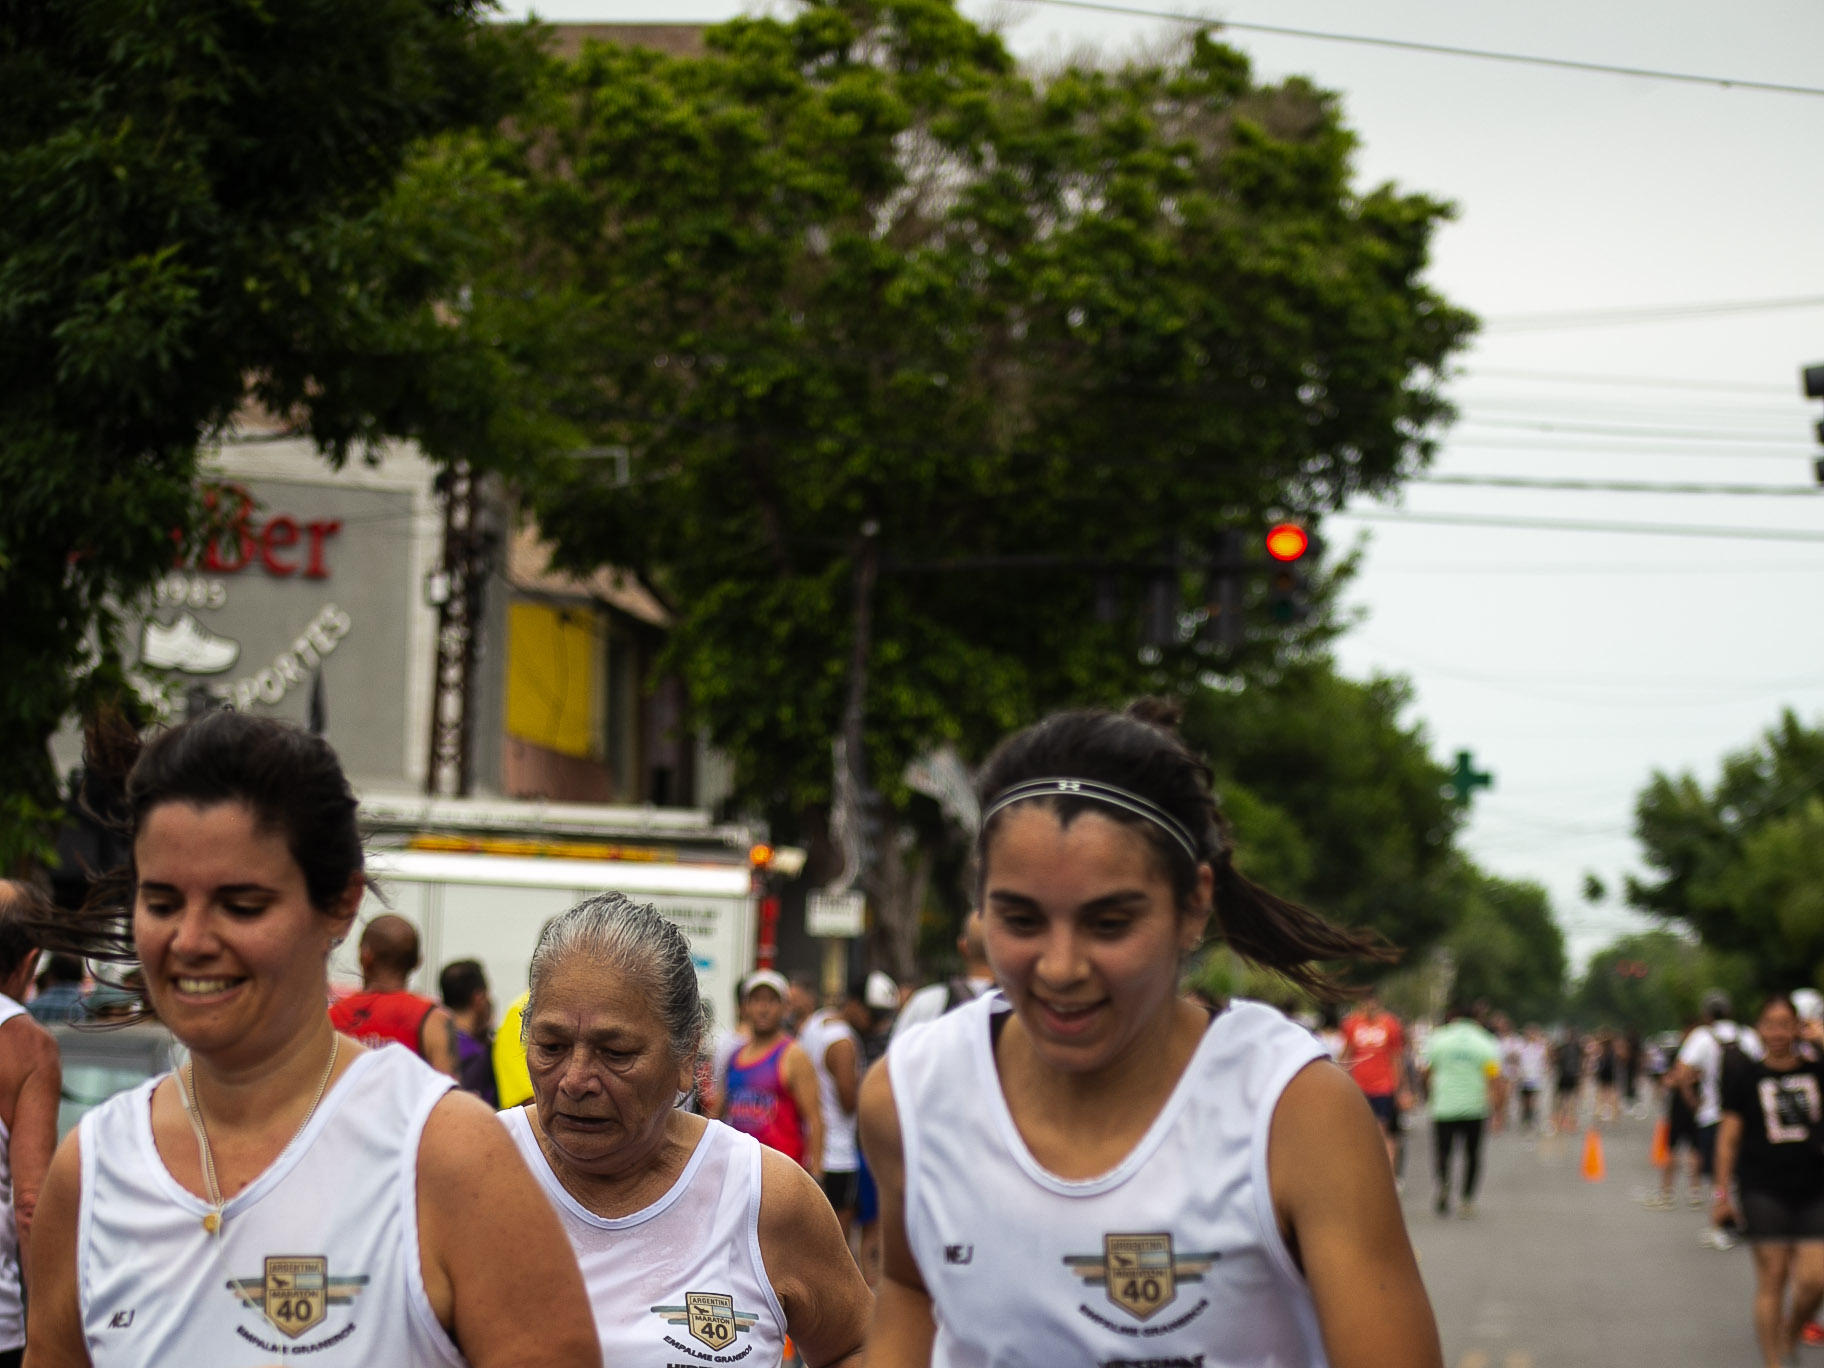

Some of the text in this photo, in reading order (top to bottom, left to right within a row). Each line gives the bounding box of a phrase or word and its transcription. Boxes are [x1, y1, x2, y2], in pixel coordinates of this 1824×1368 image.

[1123, 1278, 1160, 1302] 40
[276, 1300, 313, 1322] 40
[692, 1297, 729, 1307] ARGENTINA
[701, 1323, 728, 1340] 40
[663, 1335, 753, 1362] EMPALME GRANEROS
